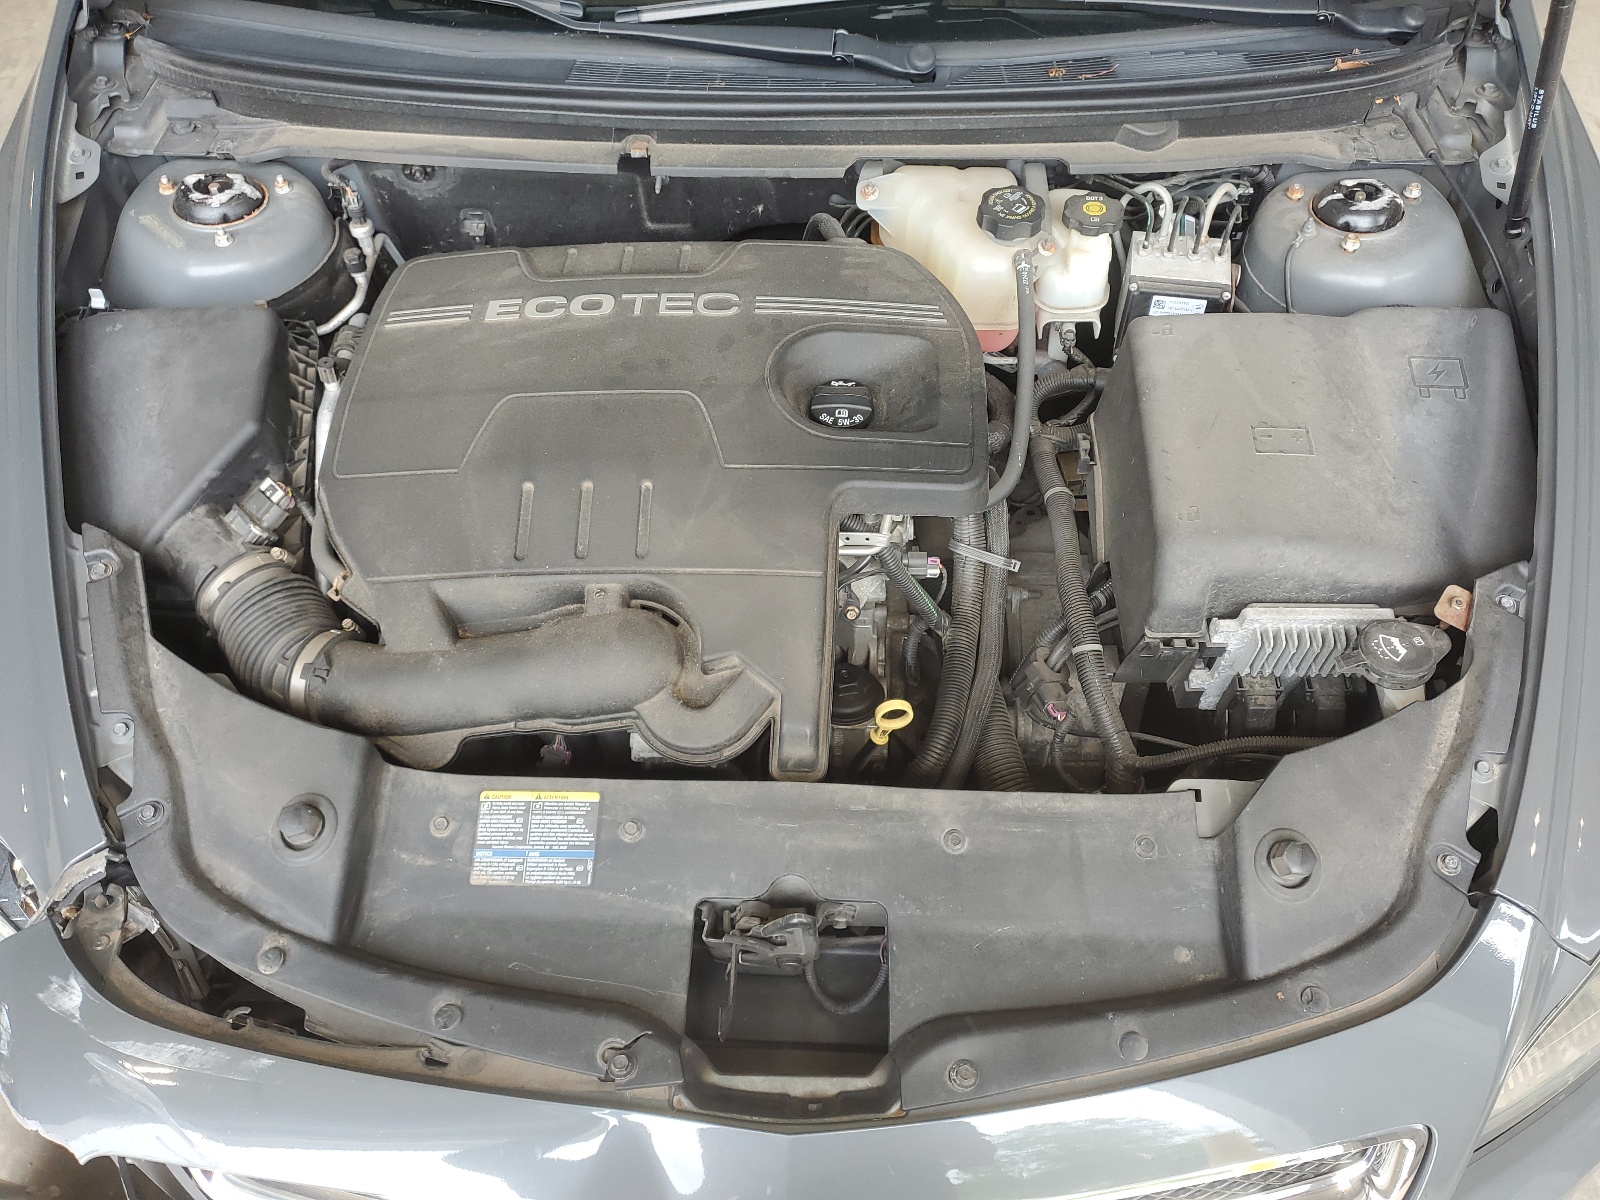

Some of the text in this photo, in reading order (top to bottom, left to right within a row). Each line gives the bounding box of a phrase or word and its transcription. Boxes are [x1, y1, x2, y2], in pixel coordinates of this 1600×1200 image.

[1530, 88, 1545, 129] STABILUS
[484, 292, 741, 322] ECOTEC
[819, 413, 864, 426] SAE 5W-30
